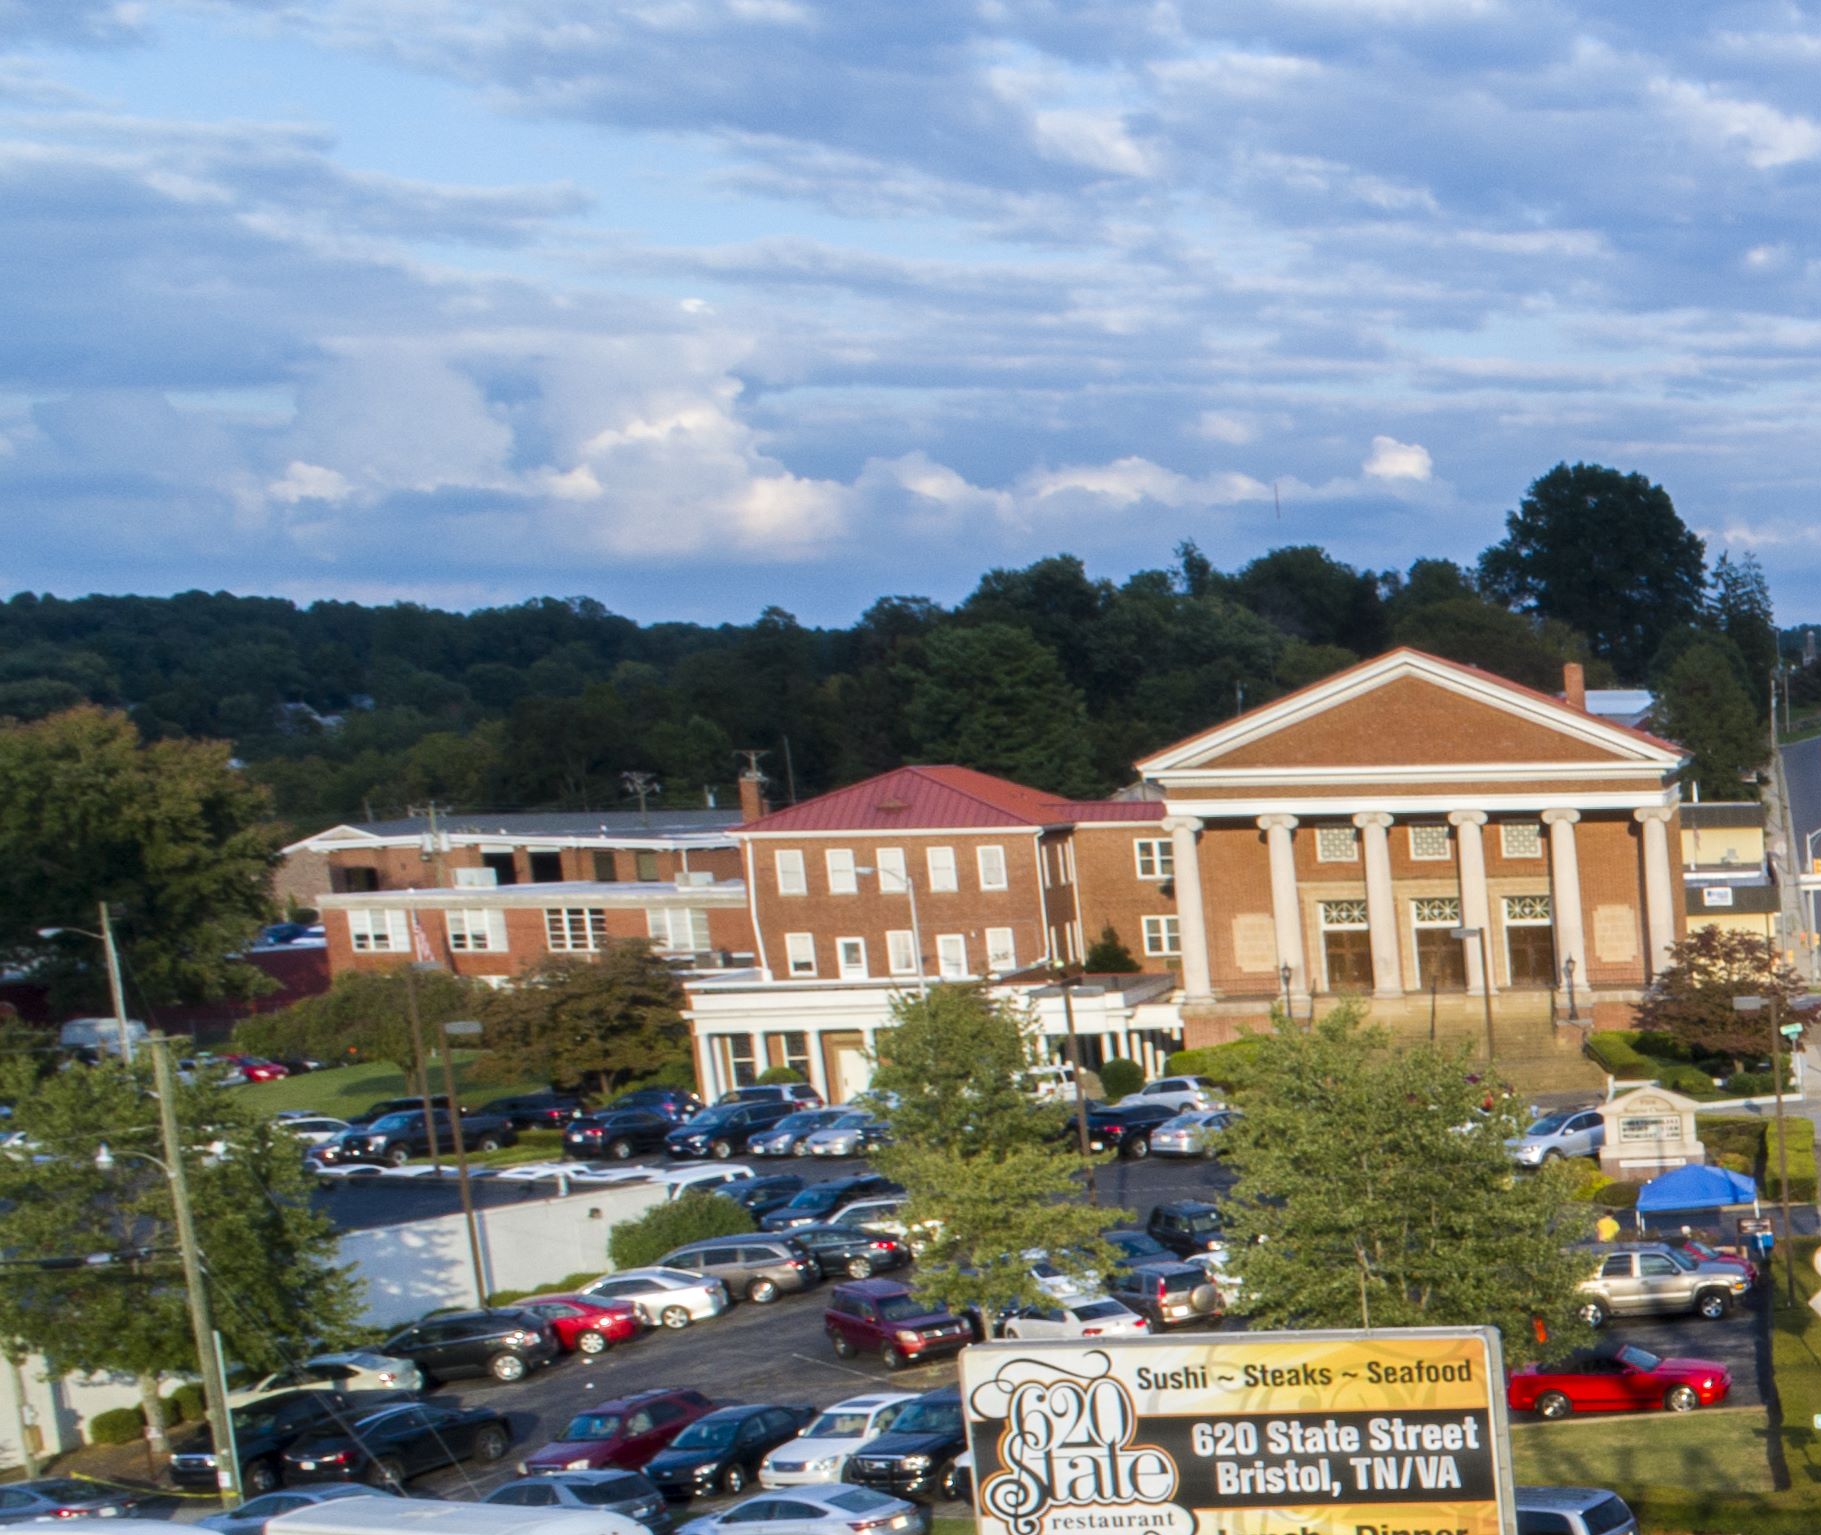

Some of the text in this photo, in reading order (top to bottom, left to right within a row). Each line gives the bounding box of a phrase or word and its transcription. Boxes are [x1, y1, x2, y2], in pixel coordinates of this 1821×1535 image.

[1136, 1366, 1208, 1390] Sushi
[1244, 1364, 1333, 1388] Steaks
[1367, 1359, 1473, 1384] Seafood
[1012, 1380, 1131, 1450] 620
[1192, 1415, 1480, 1457] 620 State Street
[986, 1432, 1173, 1530] State
[1216, 1455, 1462, 1498] Bristol, TN/VA
[1052, 1511, 1177, 1530] restaurant
